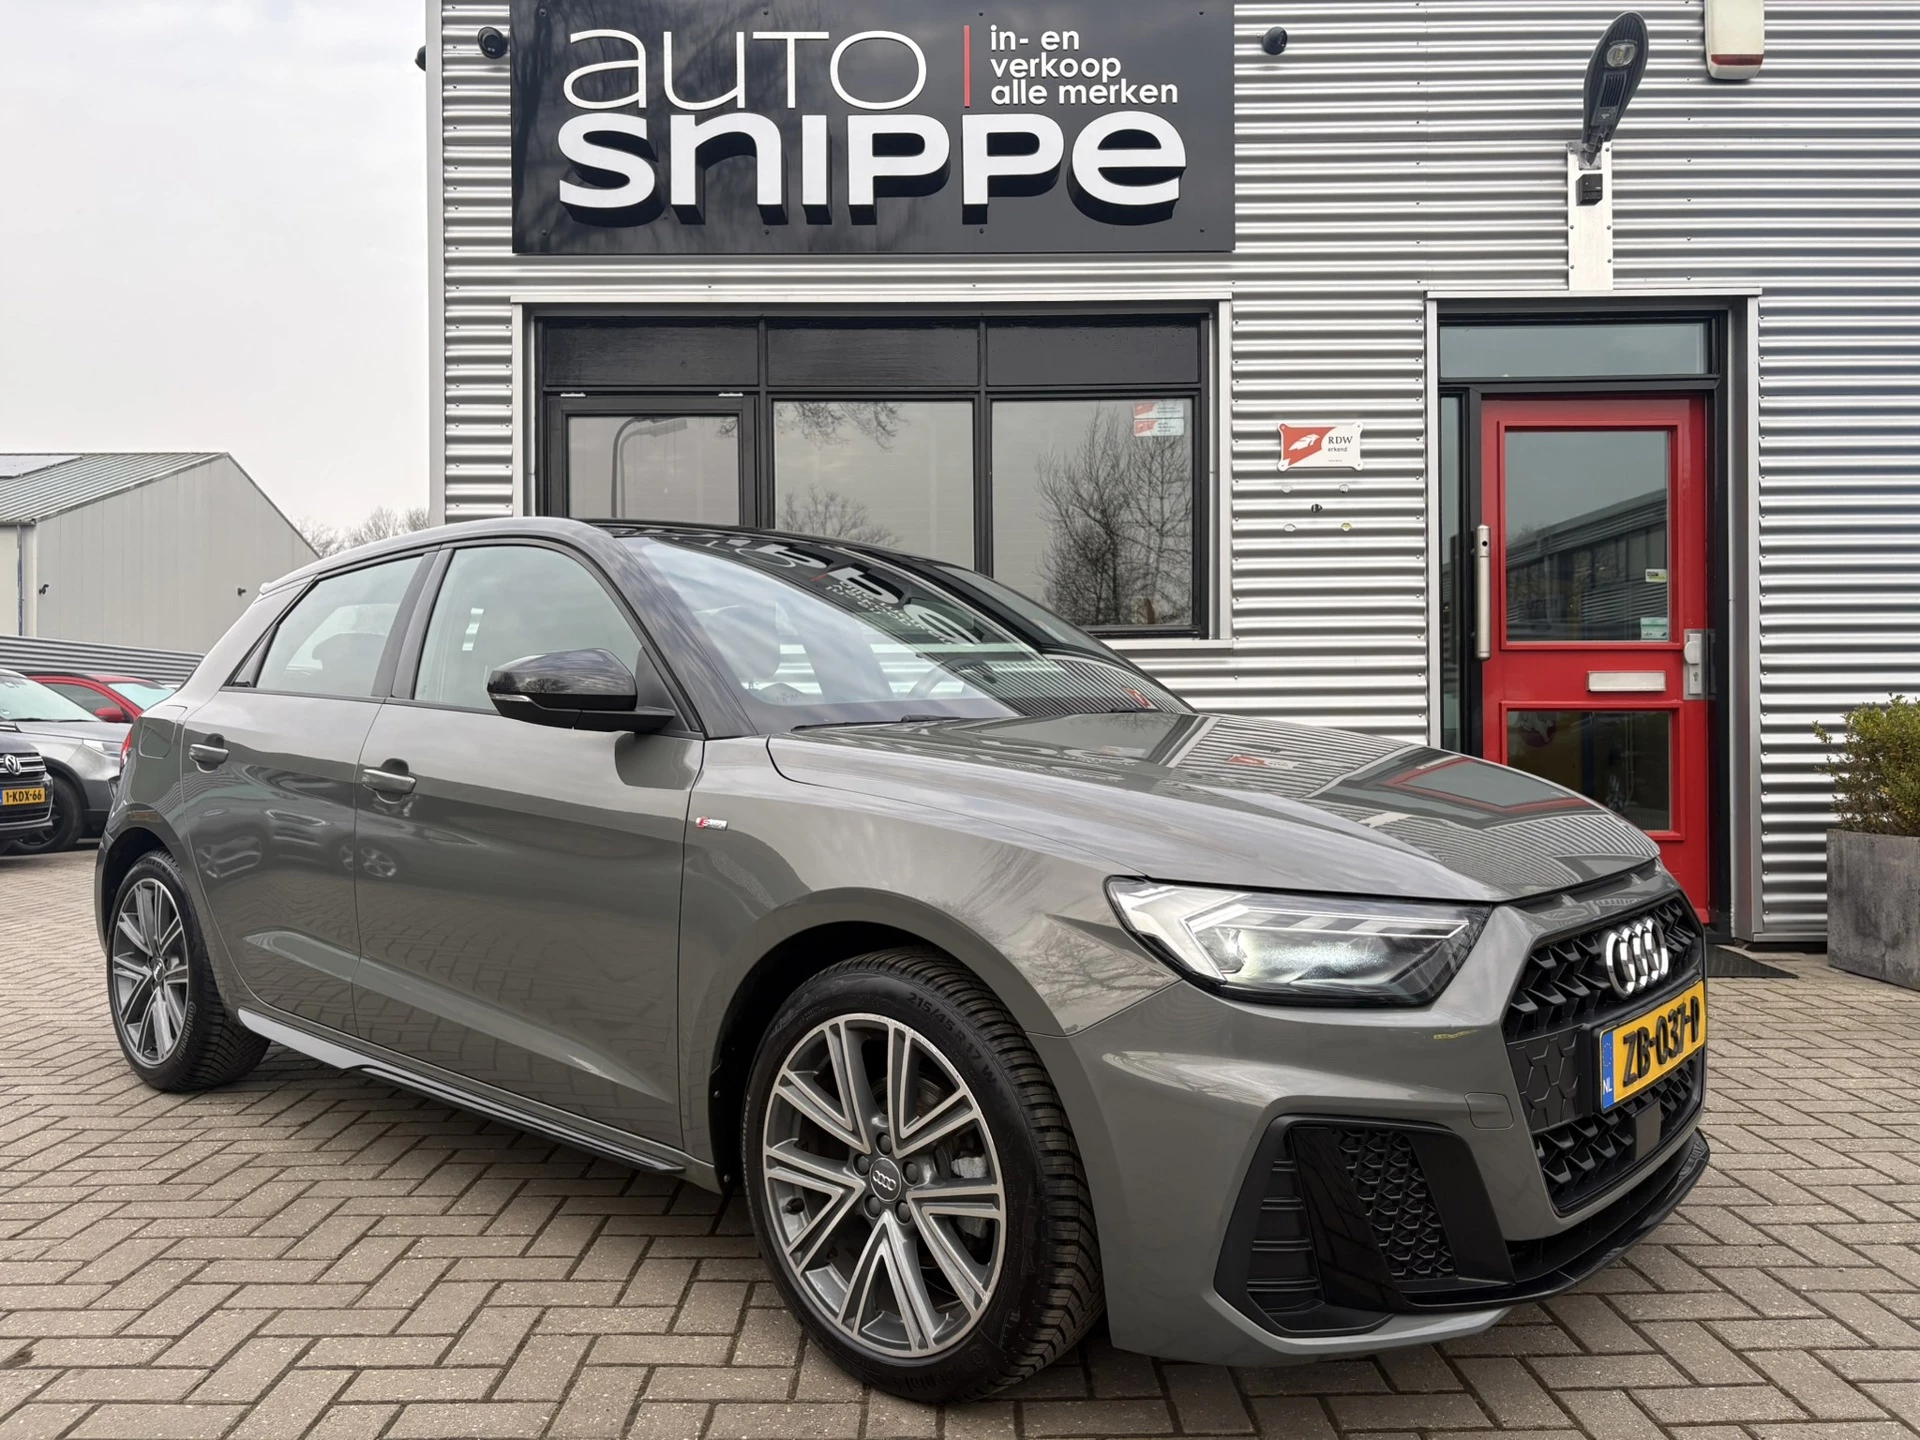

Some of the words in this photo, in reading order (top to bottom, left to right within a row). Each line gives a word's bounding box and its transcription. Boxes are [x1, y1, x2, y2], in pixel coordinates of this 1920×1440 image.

[990, 24, 1029, 51] in-
[1041, 30, 1080, 51] en
[990, 52, 1122, 83] verkoop
[991, 79, 1048, 105] alle
[1058, 78, 1178, 105] merken
[1328, 436, 1353, 445] RDW
[6, 790, 42, 803] 1-KDX-66
[907, 992, 956, 1032] 215/45
[1603, 1077, 1612, 1094] NL
